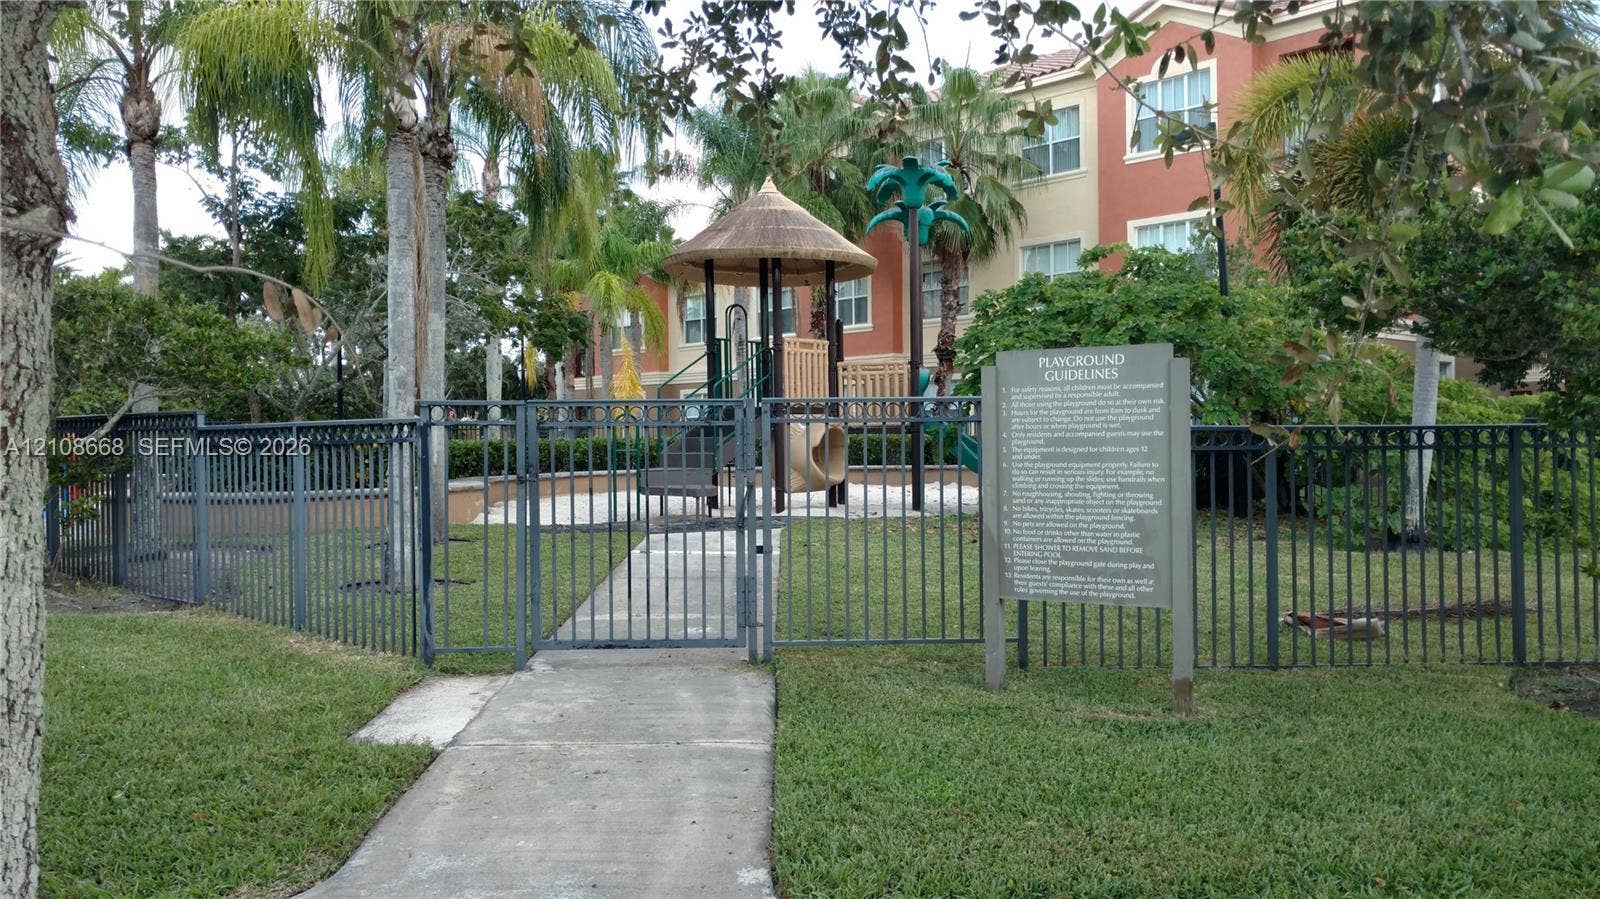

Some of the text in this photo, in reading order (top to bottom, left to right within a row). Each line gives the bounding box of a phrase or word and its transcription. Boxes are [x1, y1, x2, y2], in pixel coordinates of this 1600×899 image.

[1038, 353, 1125, 368] PLAYGROUND
[1044, 367, 1119, 382] GUIDELINES
[1122, 382, 1164, 391] accompanied
[1067, 391, 1102, 400] responsible
[1063, 400, 1098, 408] playground
[1050, 409, 1082, 417] playground
[1118, 414, 1154, 422] playground
[1068, 422, 1102, 430] playground
[1065, 430, 1105, 438] accompanied
[1075, 514, 1110, 522] playground
[1059, 560, 1093, 568] playground
[1107, 562, 1128, 570] during
[1128, 562, 1141, 570] play
[1052, 574, 1087, 583] responsible
[1048, 581, 1082, 590] compliance
[1029, 587, 1058, 596] governing
